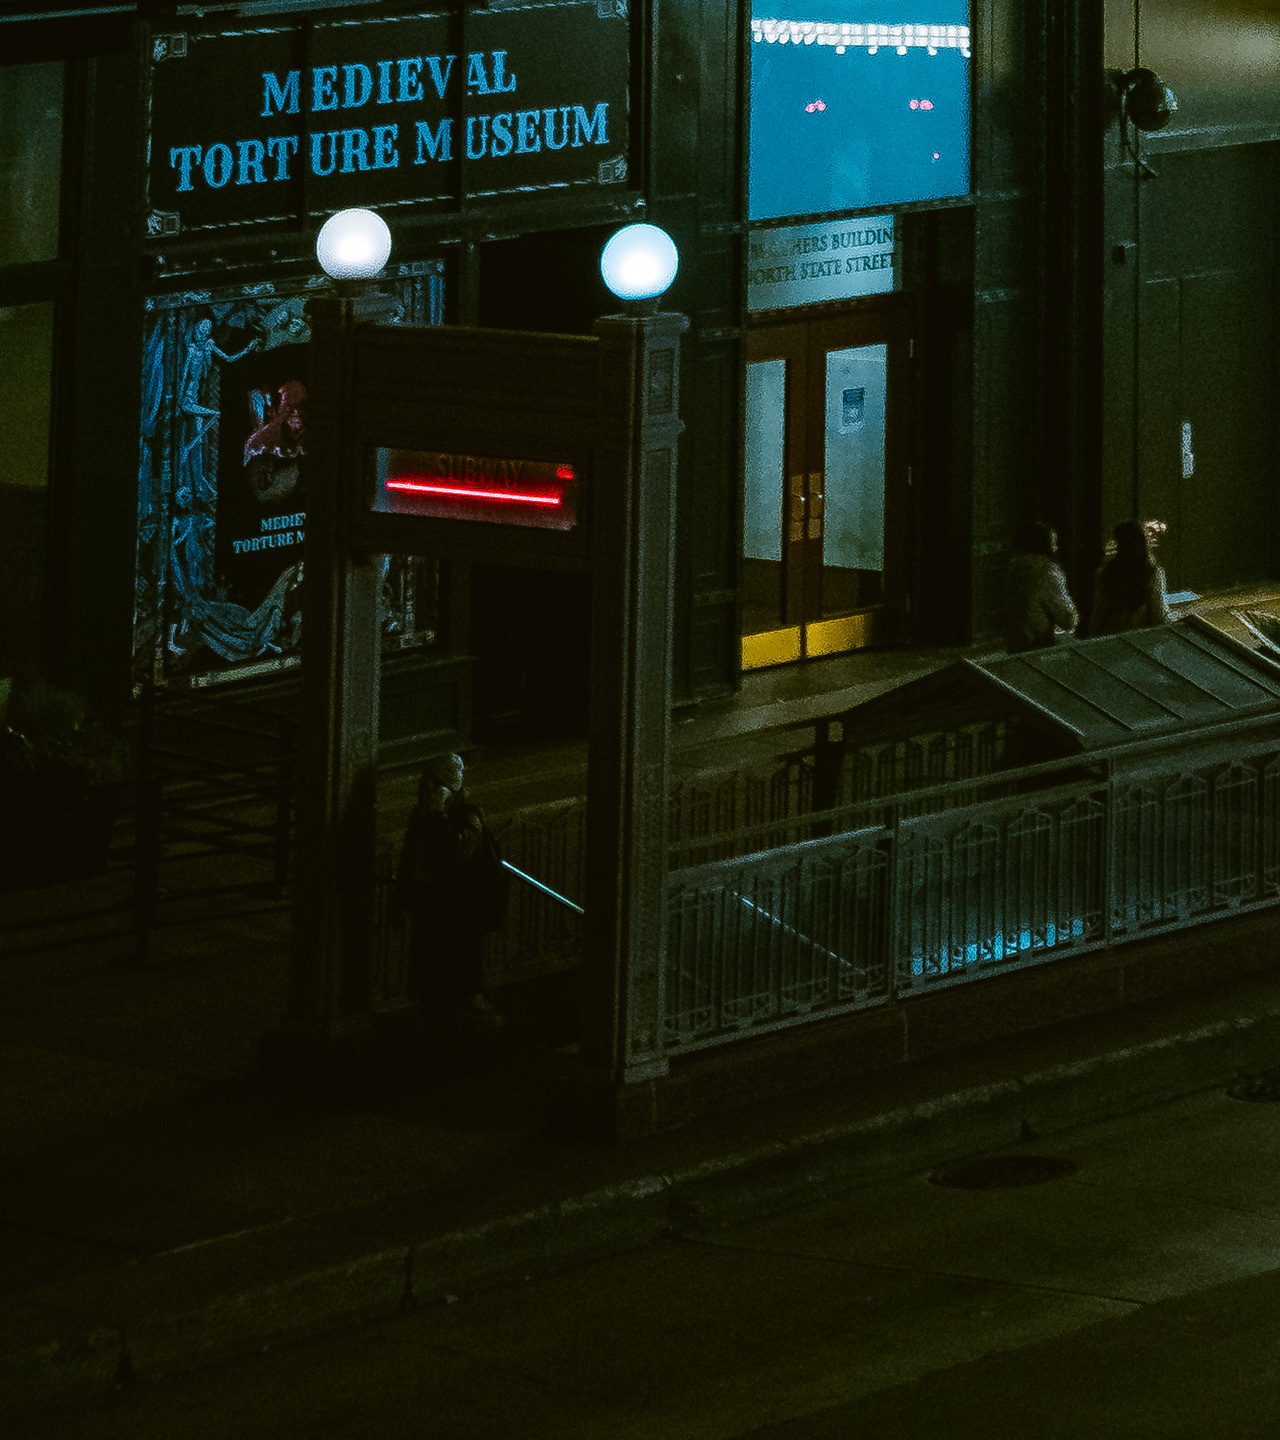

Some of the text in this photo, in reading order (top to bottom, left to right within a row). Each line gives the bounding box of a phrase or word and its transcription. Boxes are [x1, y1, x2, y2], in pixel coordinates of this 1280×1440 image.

[260, 49, 517, 117] MEDIEVAL
[169, 102, 610, 192] TORTURE MUSEUM
[800, 258, 842, 280] STATE
[845, 252, 898, 274] STREET
[260, 511, 307, 533] MEDIE
[232, 531, 295, 555] TORTURE
